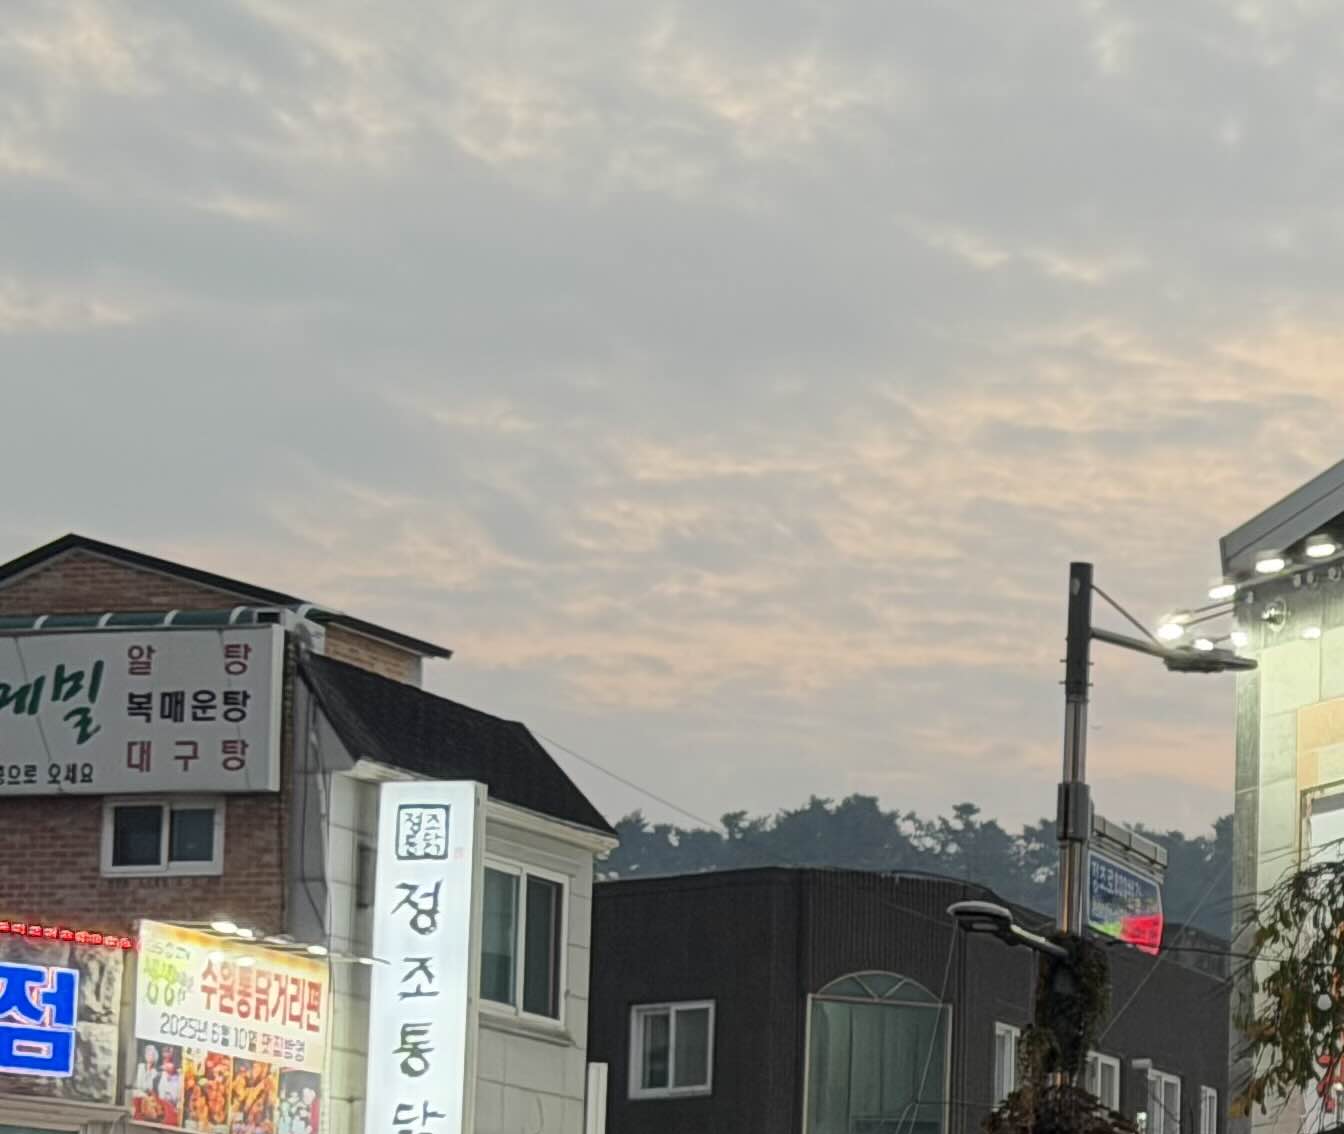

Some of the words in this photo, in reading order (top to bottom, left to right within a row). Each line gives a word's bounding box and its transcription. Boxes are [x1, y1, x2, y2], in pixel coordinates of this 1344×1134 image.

[127, 689, 250, 723] 복매운탕
[0, 764, 38, 785] 으로
[48, 762, 94, 784] 오세요
[159, 1012, 208, 1043] 2025년
